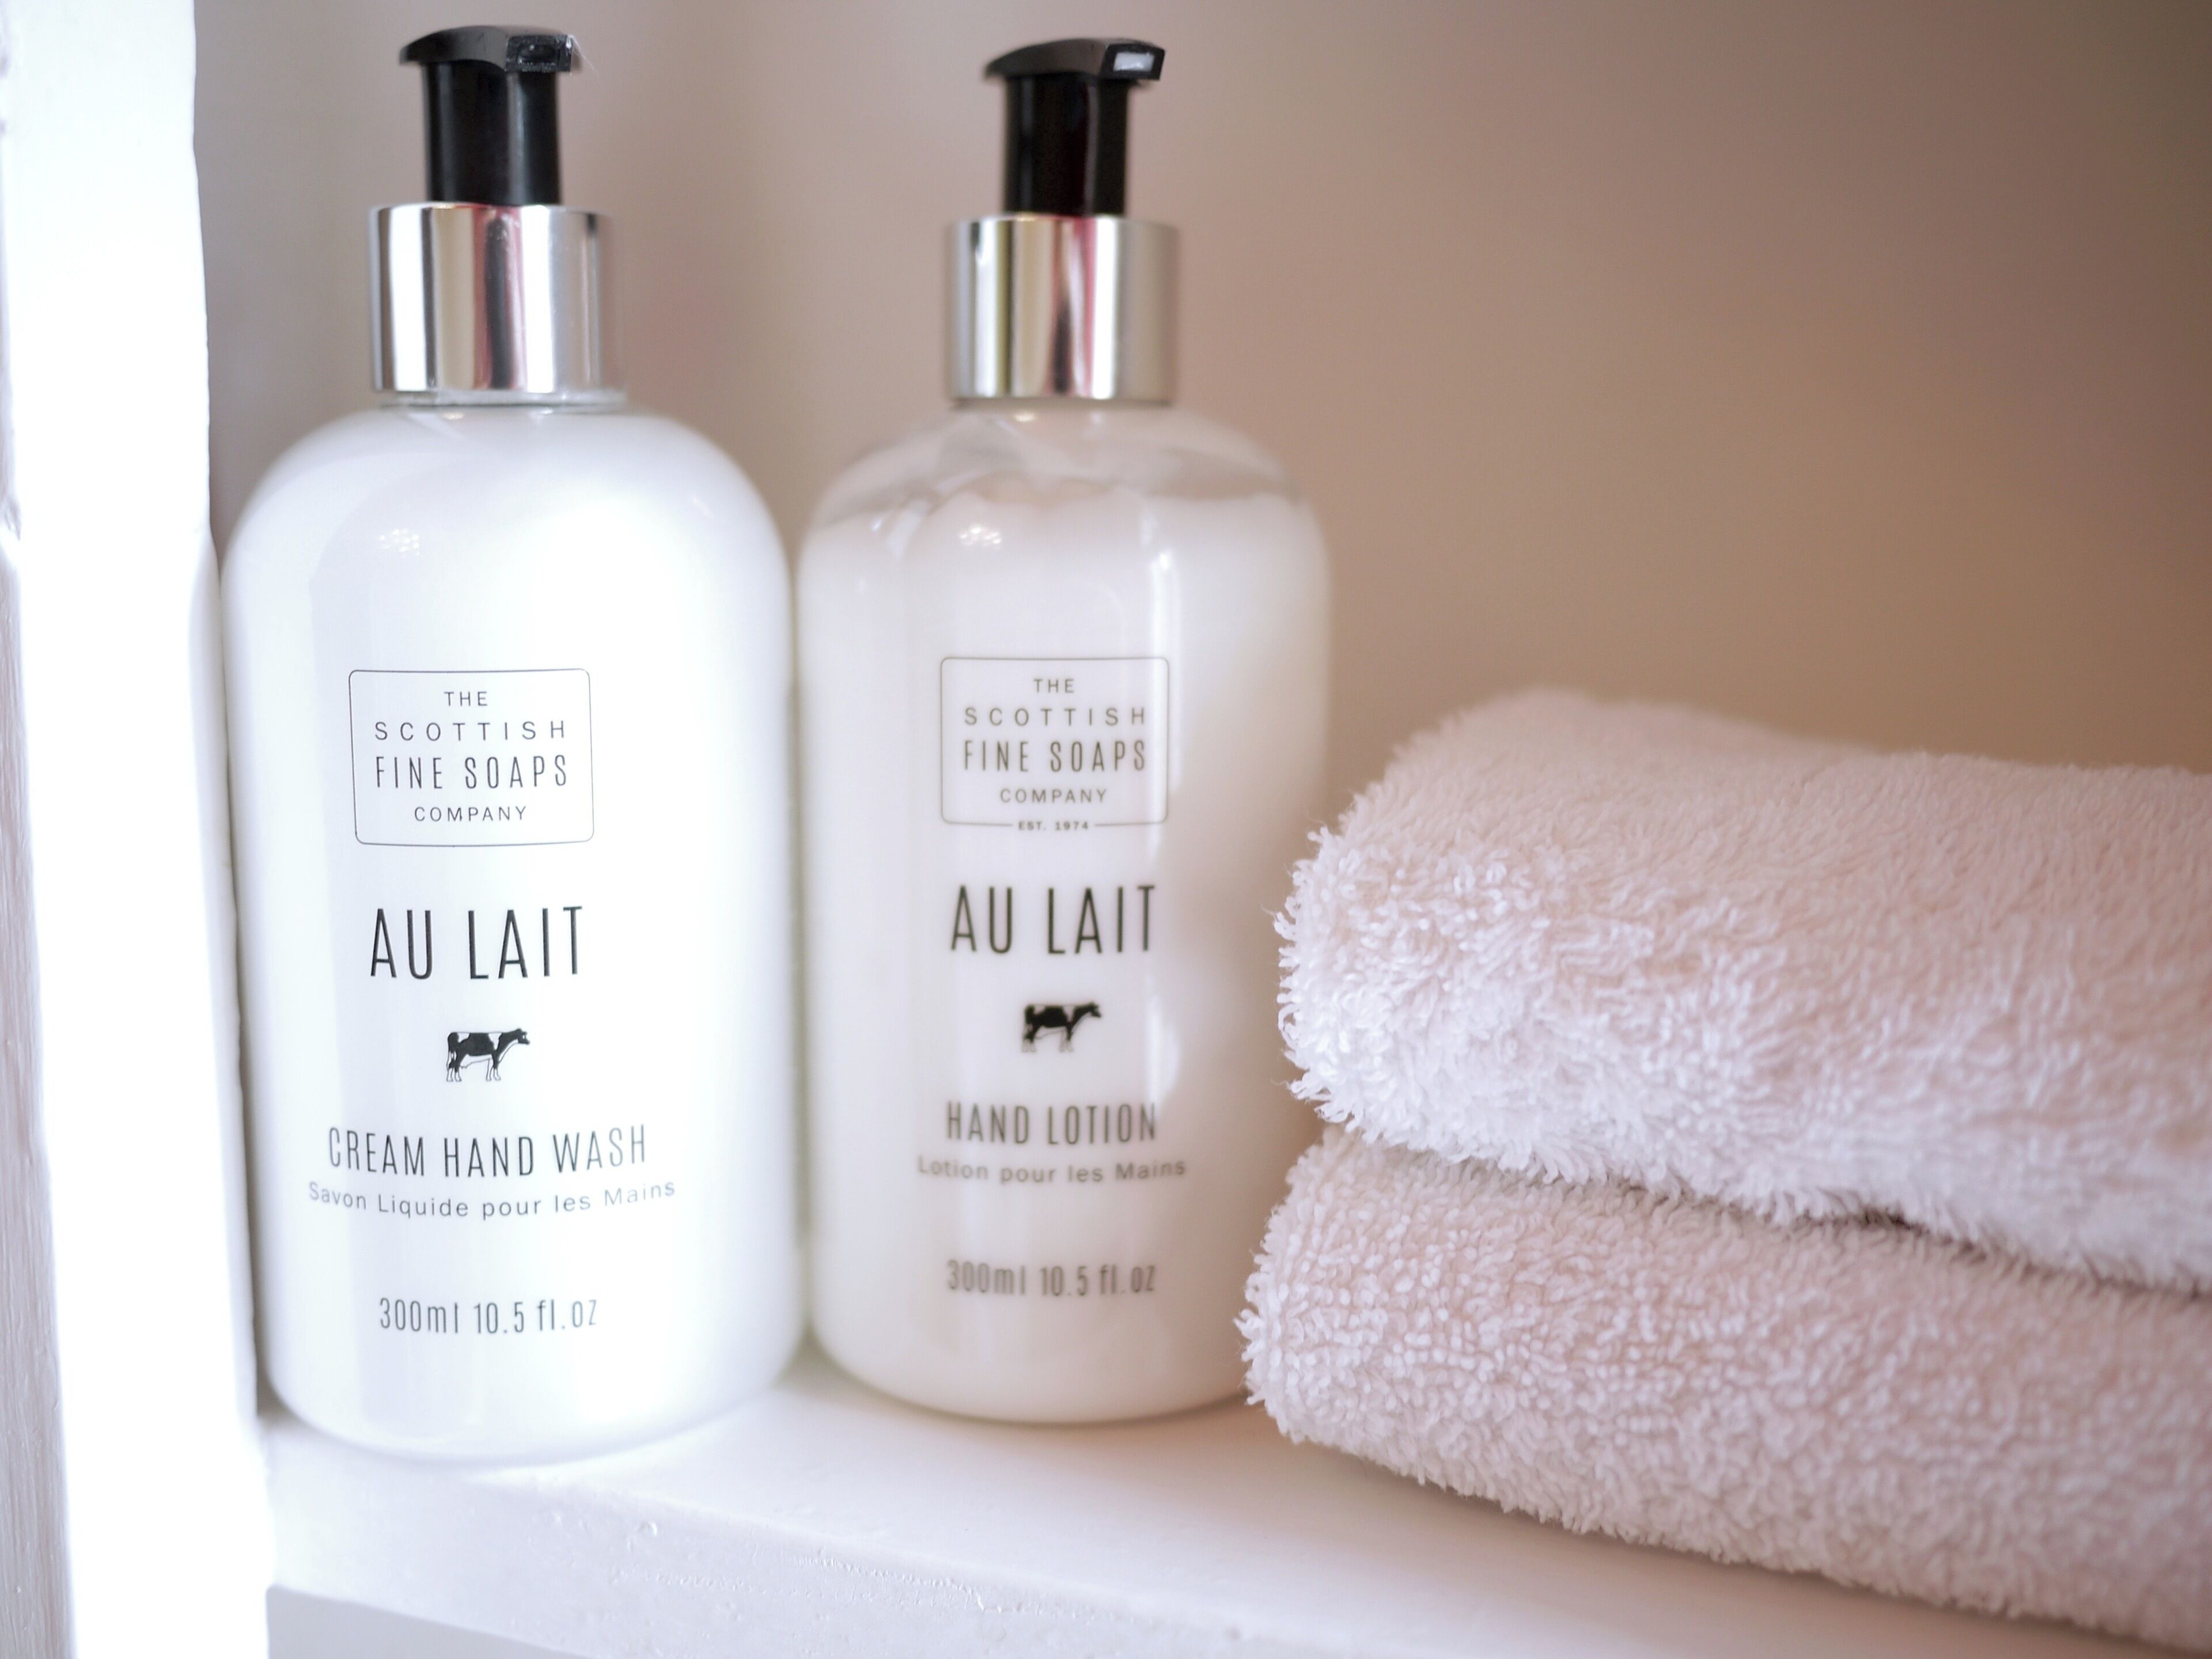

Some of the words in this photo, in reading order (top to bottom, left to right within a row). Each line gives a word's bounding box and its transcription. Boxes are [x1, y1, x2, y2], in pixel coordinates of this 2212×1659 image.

[444, 691, 488, 707] THE
[1033, 678, 1075, 694] THE
[374, 720, 565, 741] SCOTTISH
[964, 706, 1145, 727] SCOTTISH
[376, 756, 443, 789] FINE
[464, 754, 567, 789] SOAPS
[964, 740, 1030, 772] FINE
[1050, 738, 1145, 772] SOAPS
[999, 788, 1108, 804] COMPANY
[414, 805, 527, 822] COMPANY
[1018, 820, 1047, 832] EST.
[1054, 820, 1089, 832] 1974
[950, 884, 1013, 955] AU
[1047, 884, 1156, 955] LAIT
[370, 907, 433, 980] AU
[467, 905, 583, 980] LAIT
[946, 1100, 1031, 1145] HAND
[1047, 1101, 1157, 1145] LOTION
[328, 1126, 425, 1177] CREAM
[444, 1135, 535, 1178] HAND
[552, 1123, 646, 1174] WASH
[917, 1156, 989, 1181] Lotion
[999, 1165, 1056, 1186] pour
[1067, 1165, 1104, 1183] les
[1115, 1158, 1187, 1181] Mains
[308, 1180, 368, 1210] Savon
[377, 1193, 469, 1219] Liquide
[482, 1198, 541, 1221] pour
[554, 1192, 592, 1213] les
[603, 1180, 676, 1207] Mains
[946, 1259, 1027, 1296] 300ml
[1038, 1264, 1089, 1297] 10.5
[379, 1296, 459, 1334] 300ml
[473, 1301, 525, 1334] 10.5
